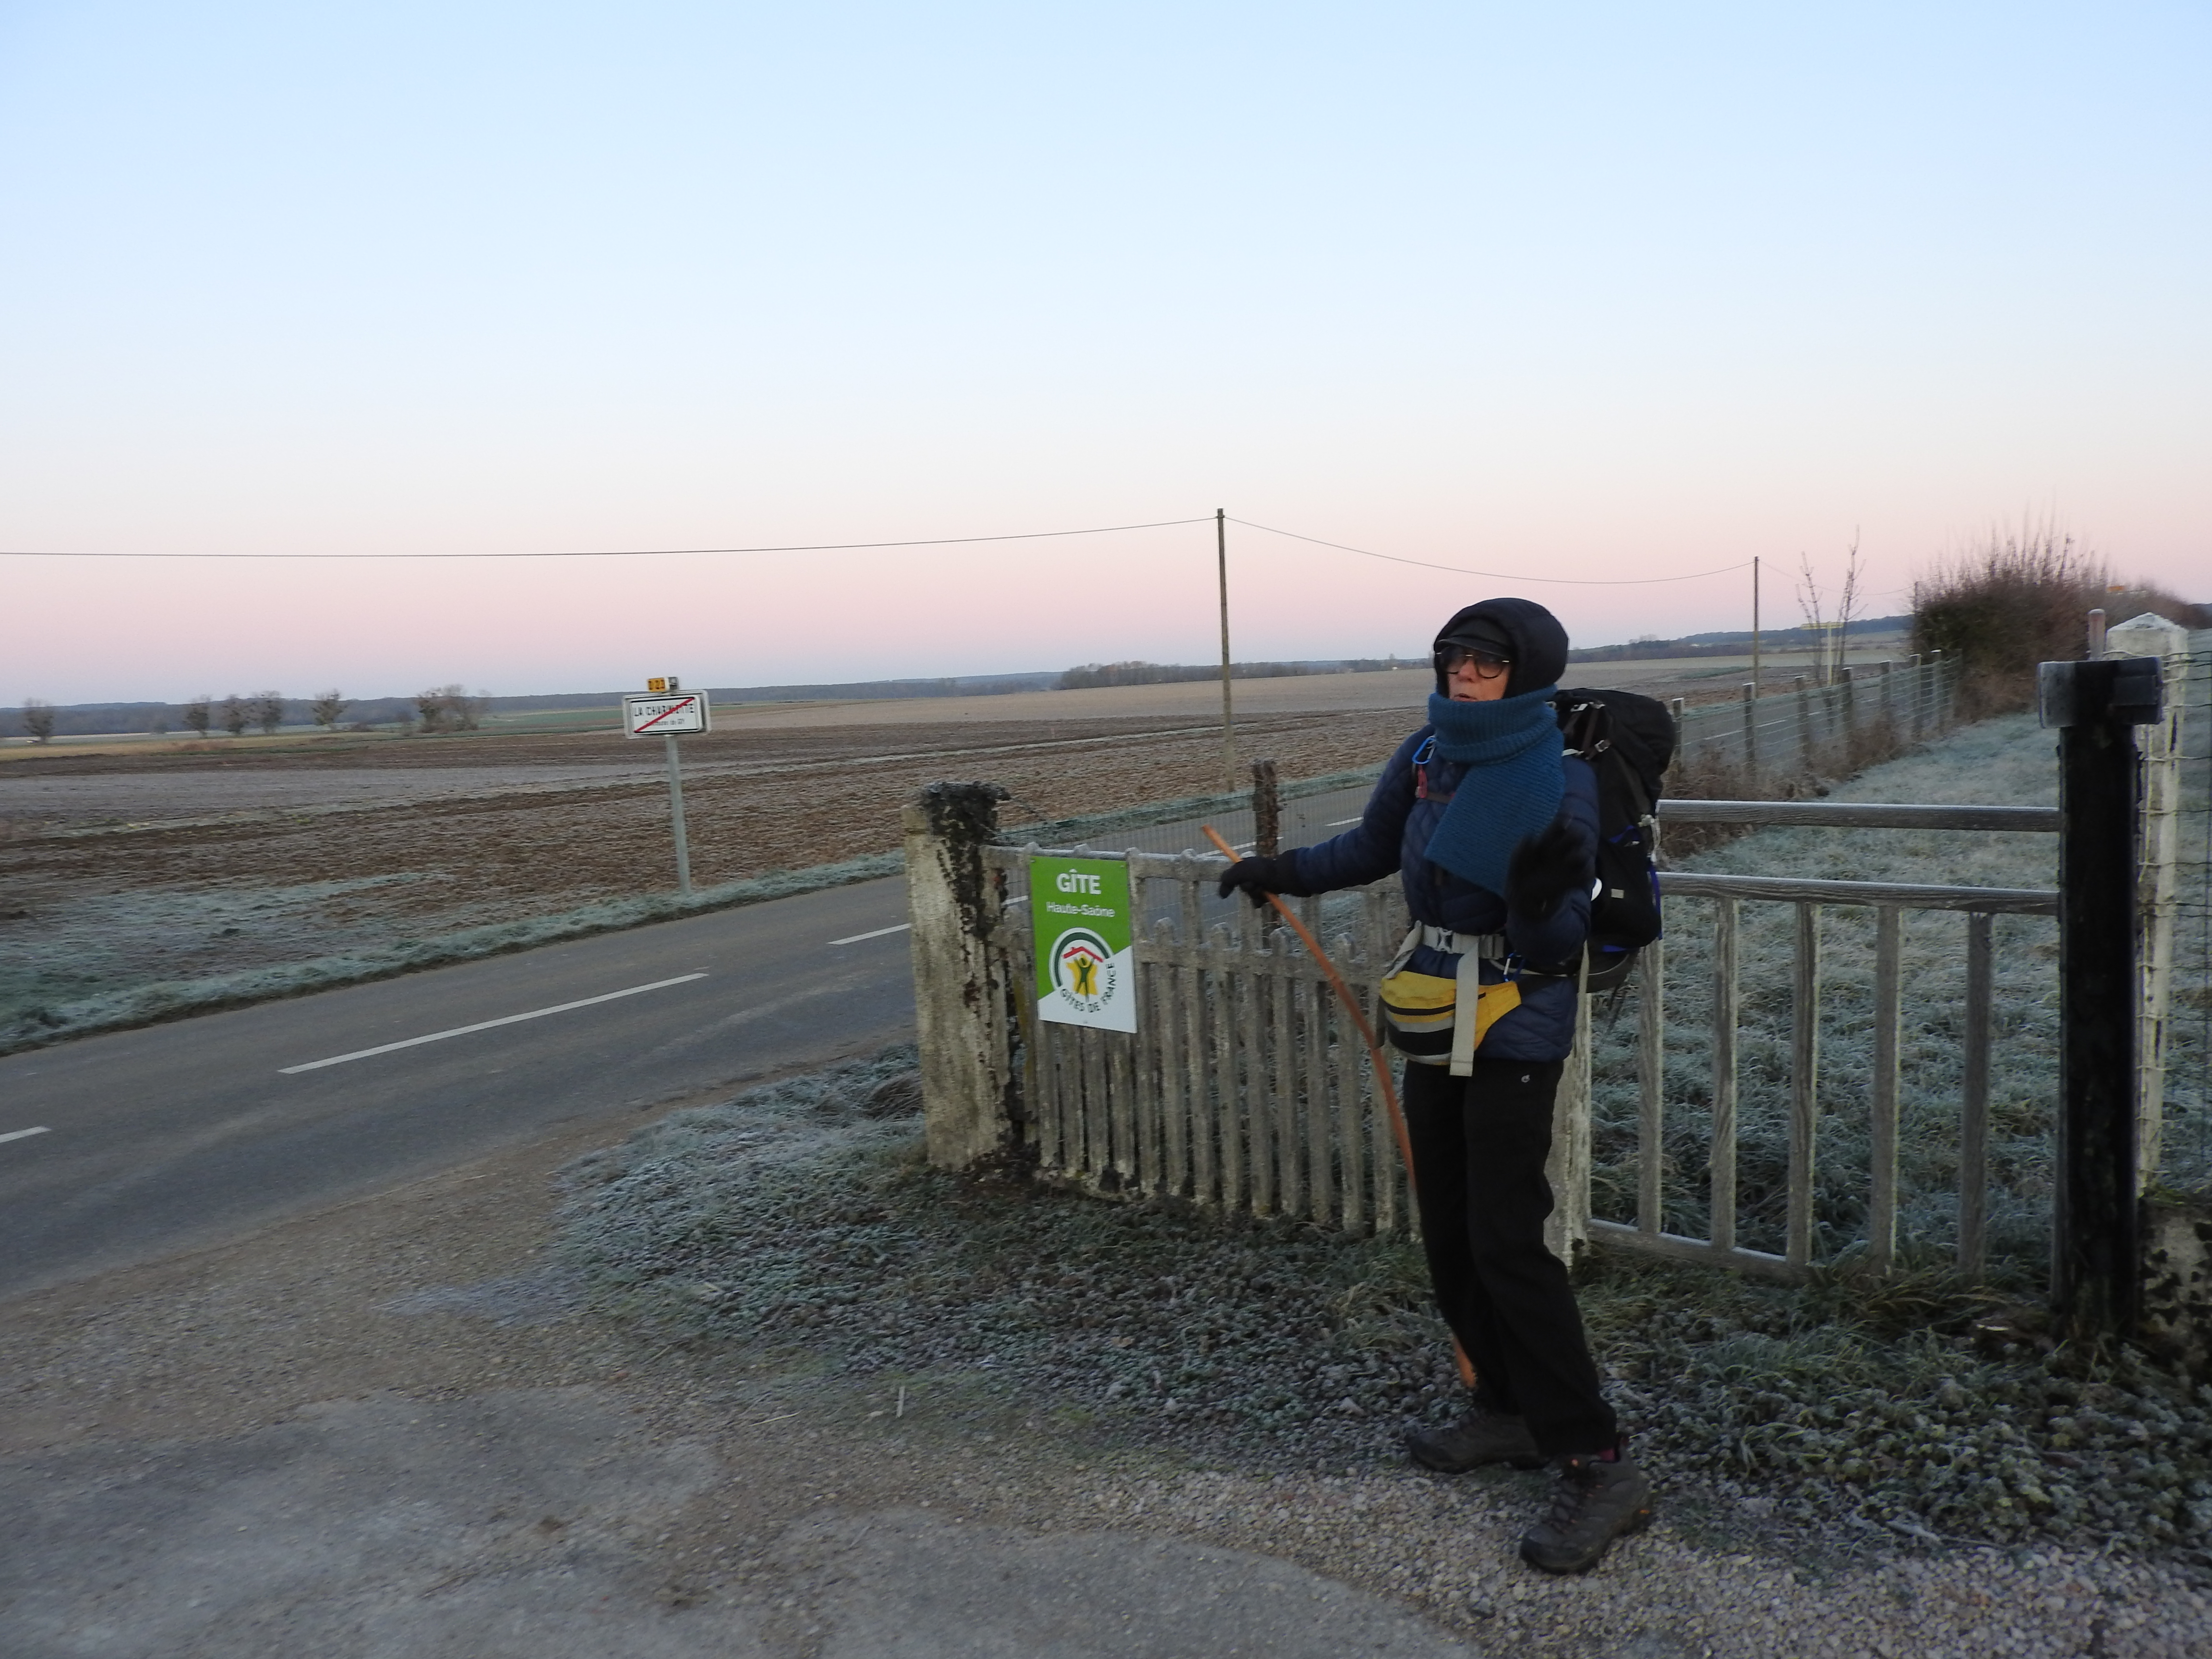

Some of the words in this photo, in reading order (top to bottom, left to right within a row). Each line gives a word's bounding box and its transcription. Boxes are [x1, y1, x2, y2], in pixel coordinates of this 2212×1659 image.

[635, 707, 643, 716] LA
[1056, 869, 1102, 894] GÎTE
[1046, 902, 1115, 917] Haute-Saône
[1087, 1002, 1101, 1013] DE
[1100, 963, 1116, 1005] FRANCE
